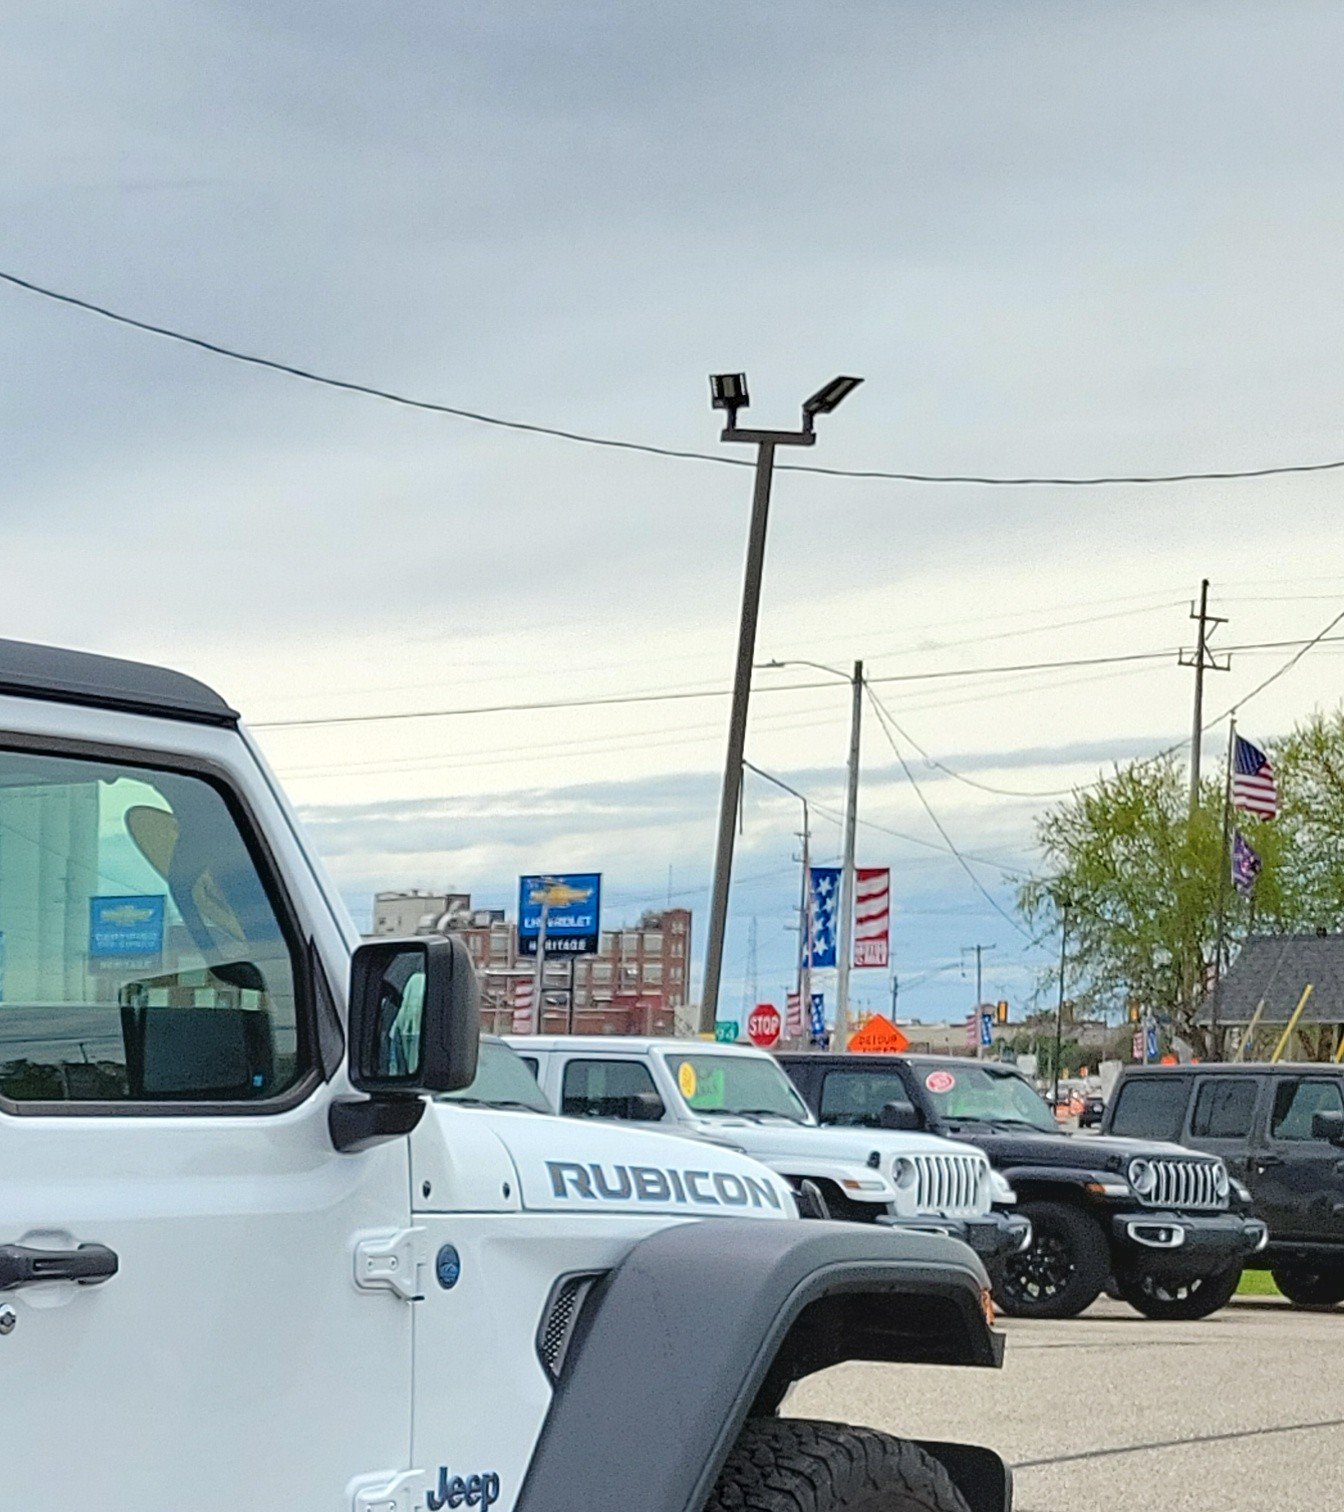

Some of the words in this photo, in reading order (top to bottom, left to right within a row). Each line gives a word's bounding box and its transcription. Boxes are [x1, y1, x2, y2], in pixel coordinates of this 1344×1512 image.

[524, 915, 592, 929] CHVROLET
[528, 939, 587, 951] HRITAGE
[750, 1014, 779, 1036] STOP
[544, 1160, 782, 1210] RUBICON
